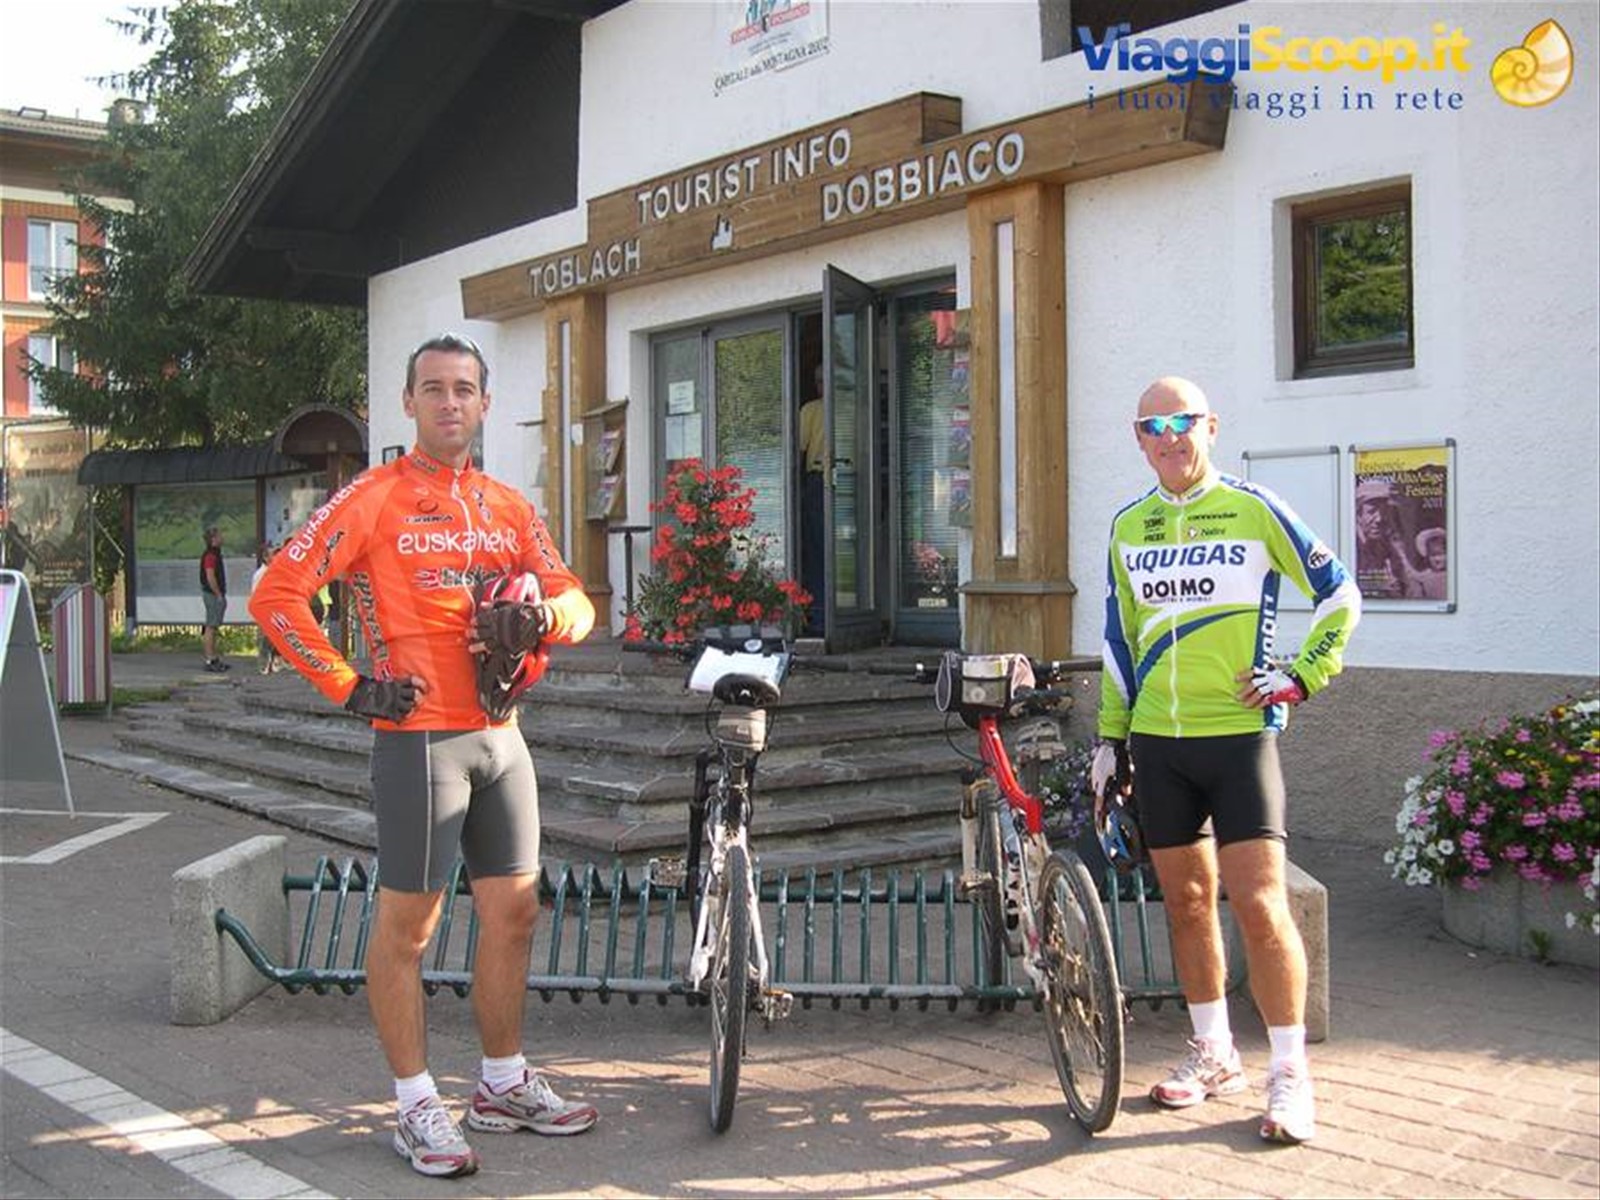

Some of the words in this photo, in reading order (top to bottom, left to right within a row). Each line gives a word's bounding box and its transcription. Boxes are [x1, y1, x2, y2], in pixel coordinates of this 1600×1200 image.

[637, 156, 761, 225] TOURIST
[770, 127, 853, 186] INFO
[822, 131, 1026, 222] DOBBIACO
[528, 239, 641, 297] TOBLACH
[1126, 543, 1247, 574] LIQUIGAS
